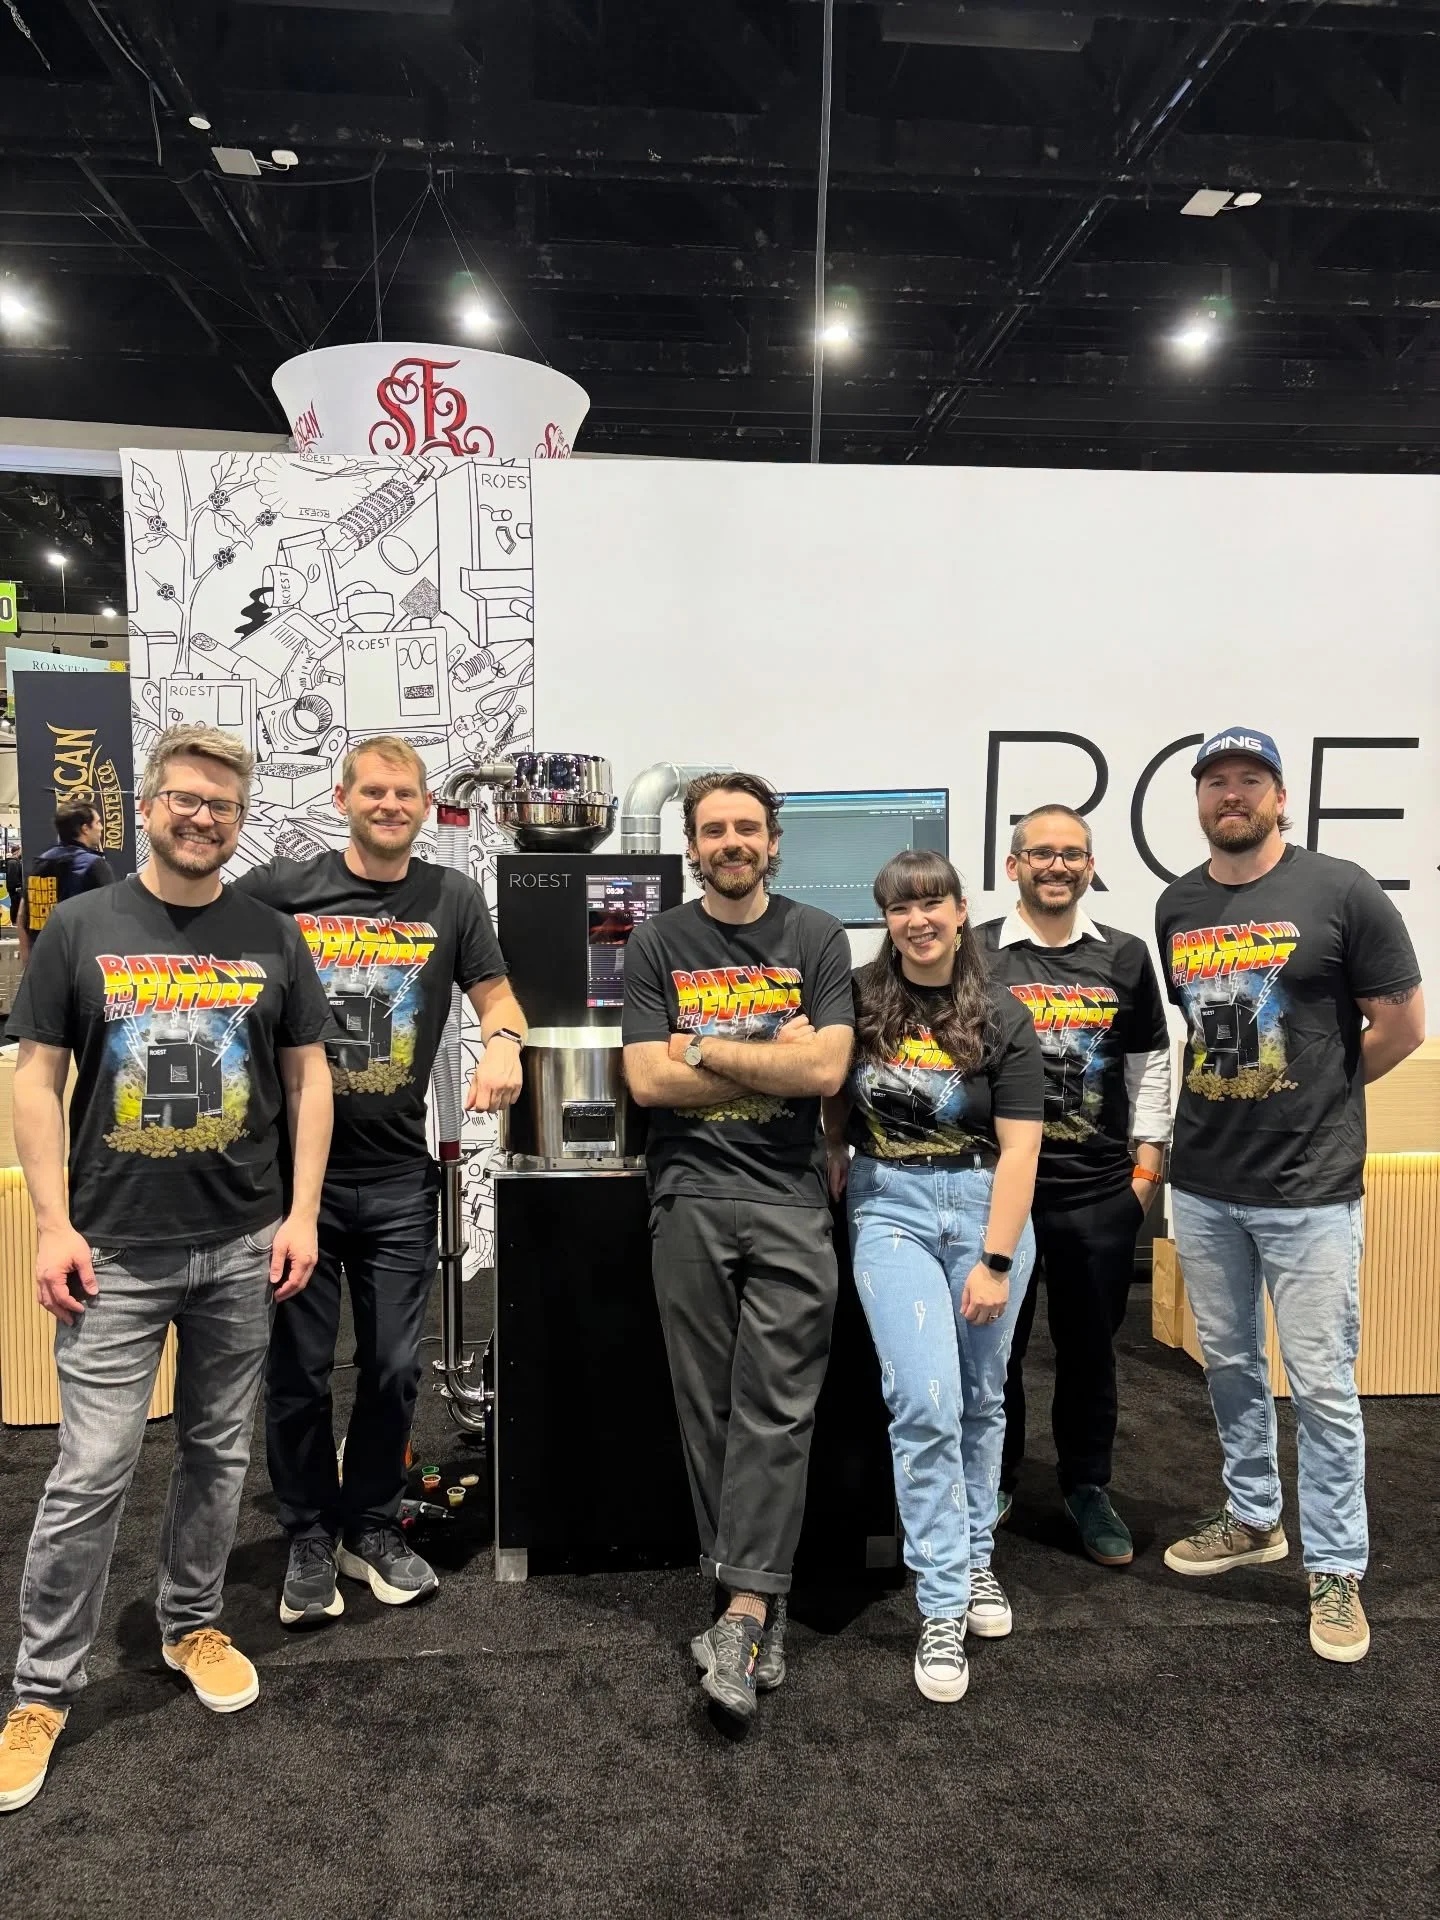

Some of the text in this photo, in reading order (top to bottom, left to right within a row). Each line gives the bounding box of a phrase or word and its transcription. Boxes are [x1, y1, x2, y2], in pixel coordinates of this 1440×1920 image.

[481, 473, 530, 488] ROES
[280, 571, 291, 604] ROEST
[346, 637, 390, 651] ROEST
[170, 685, 215, 697] ROEST
[1206, 736, 1262, 755] PING
[104, 783, 122, 850] ROASTER
[509, 873, 572, 888] ROEST
[1172, 922, 1256, 959] BATCH
[317, 941, 435, 970] FUTURE
[1186, 943, 1297, 985] FUTURE
[96, 954, 222, 986] BATCH
[104, 985, 133, 1004] TO
[671, 965, 772, 1001] BATCH
[104, 1001, 135, 1022] THE
[133, 983, 264, 1016] FUTURE
[679, 998, 700, 1015] TO
[700, 988, 802, 1025] FUTURE
[677, 1013, 701, 1030] THE
